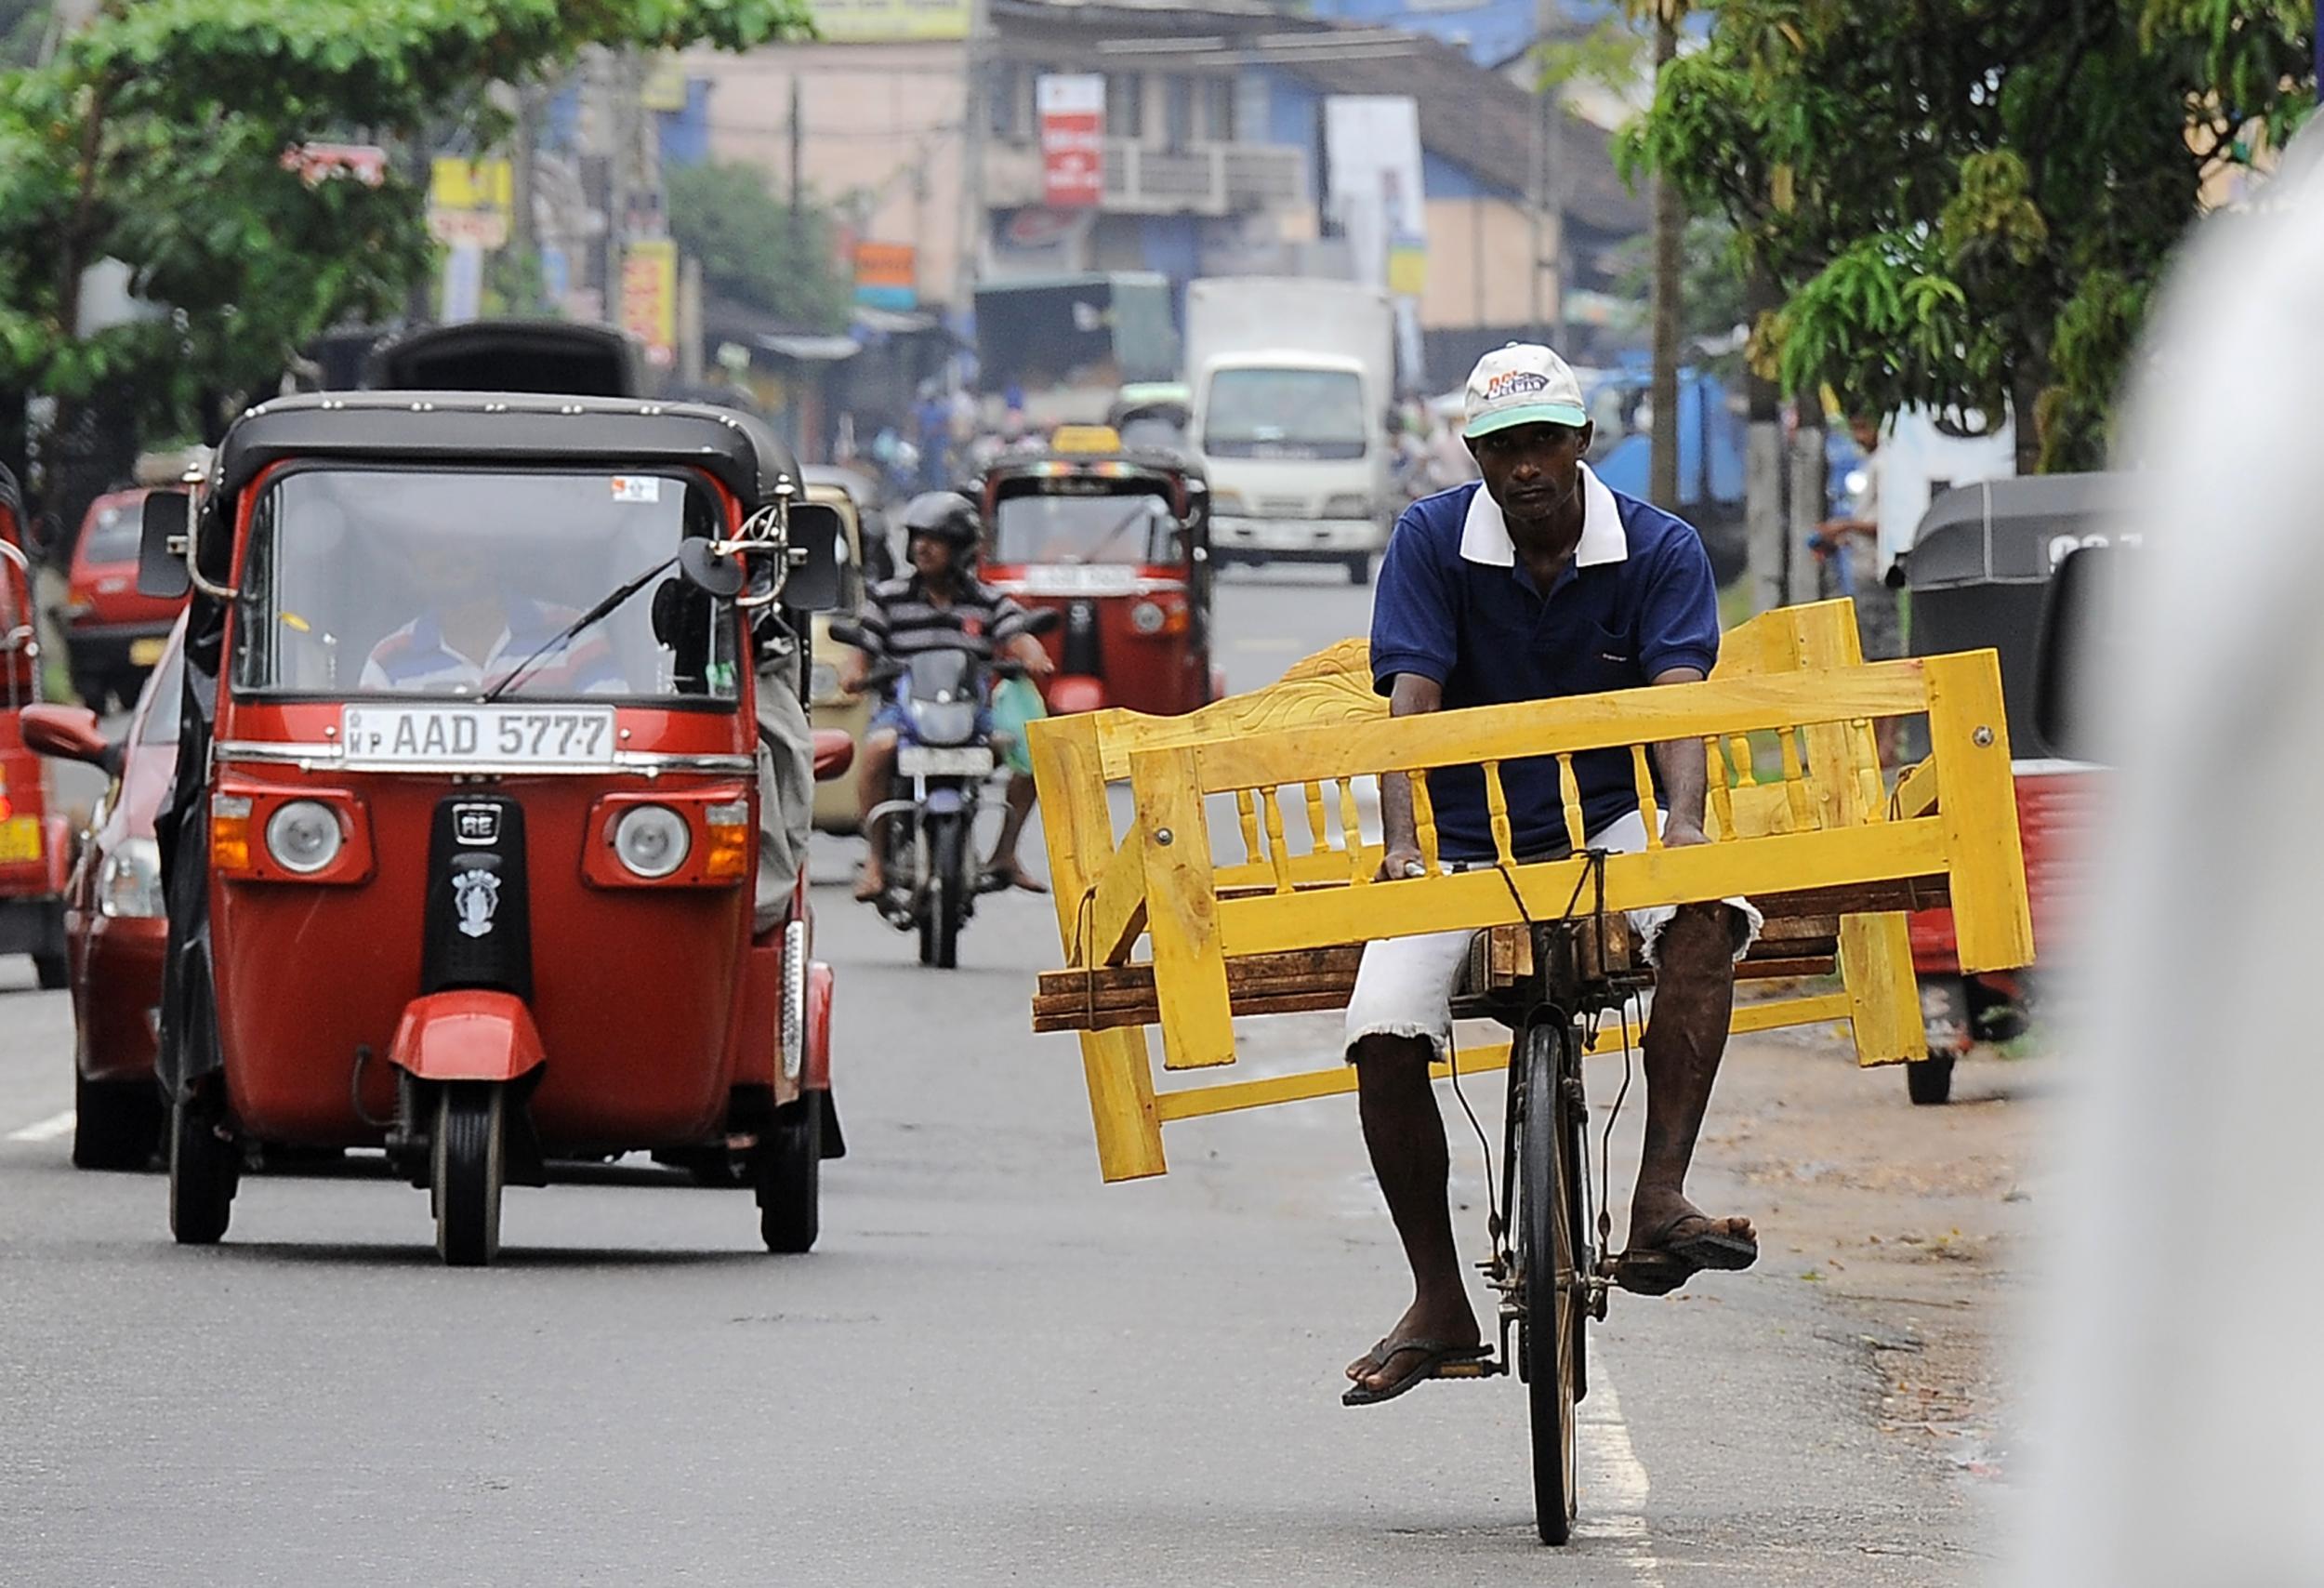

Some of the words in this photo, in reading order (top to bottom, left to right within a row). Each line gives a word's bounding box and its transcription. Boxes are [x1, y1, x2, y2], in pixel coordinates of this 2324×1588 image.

[392, 713, 478, 755] AAD
[498, 715, 607, 756] 5777
[461, 816, 494, 836] RE
